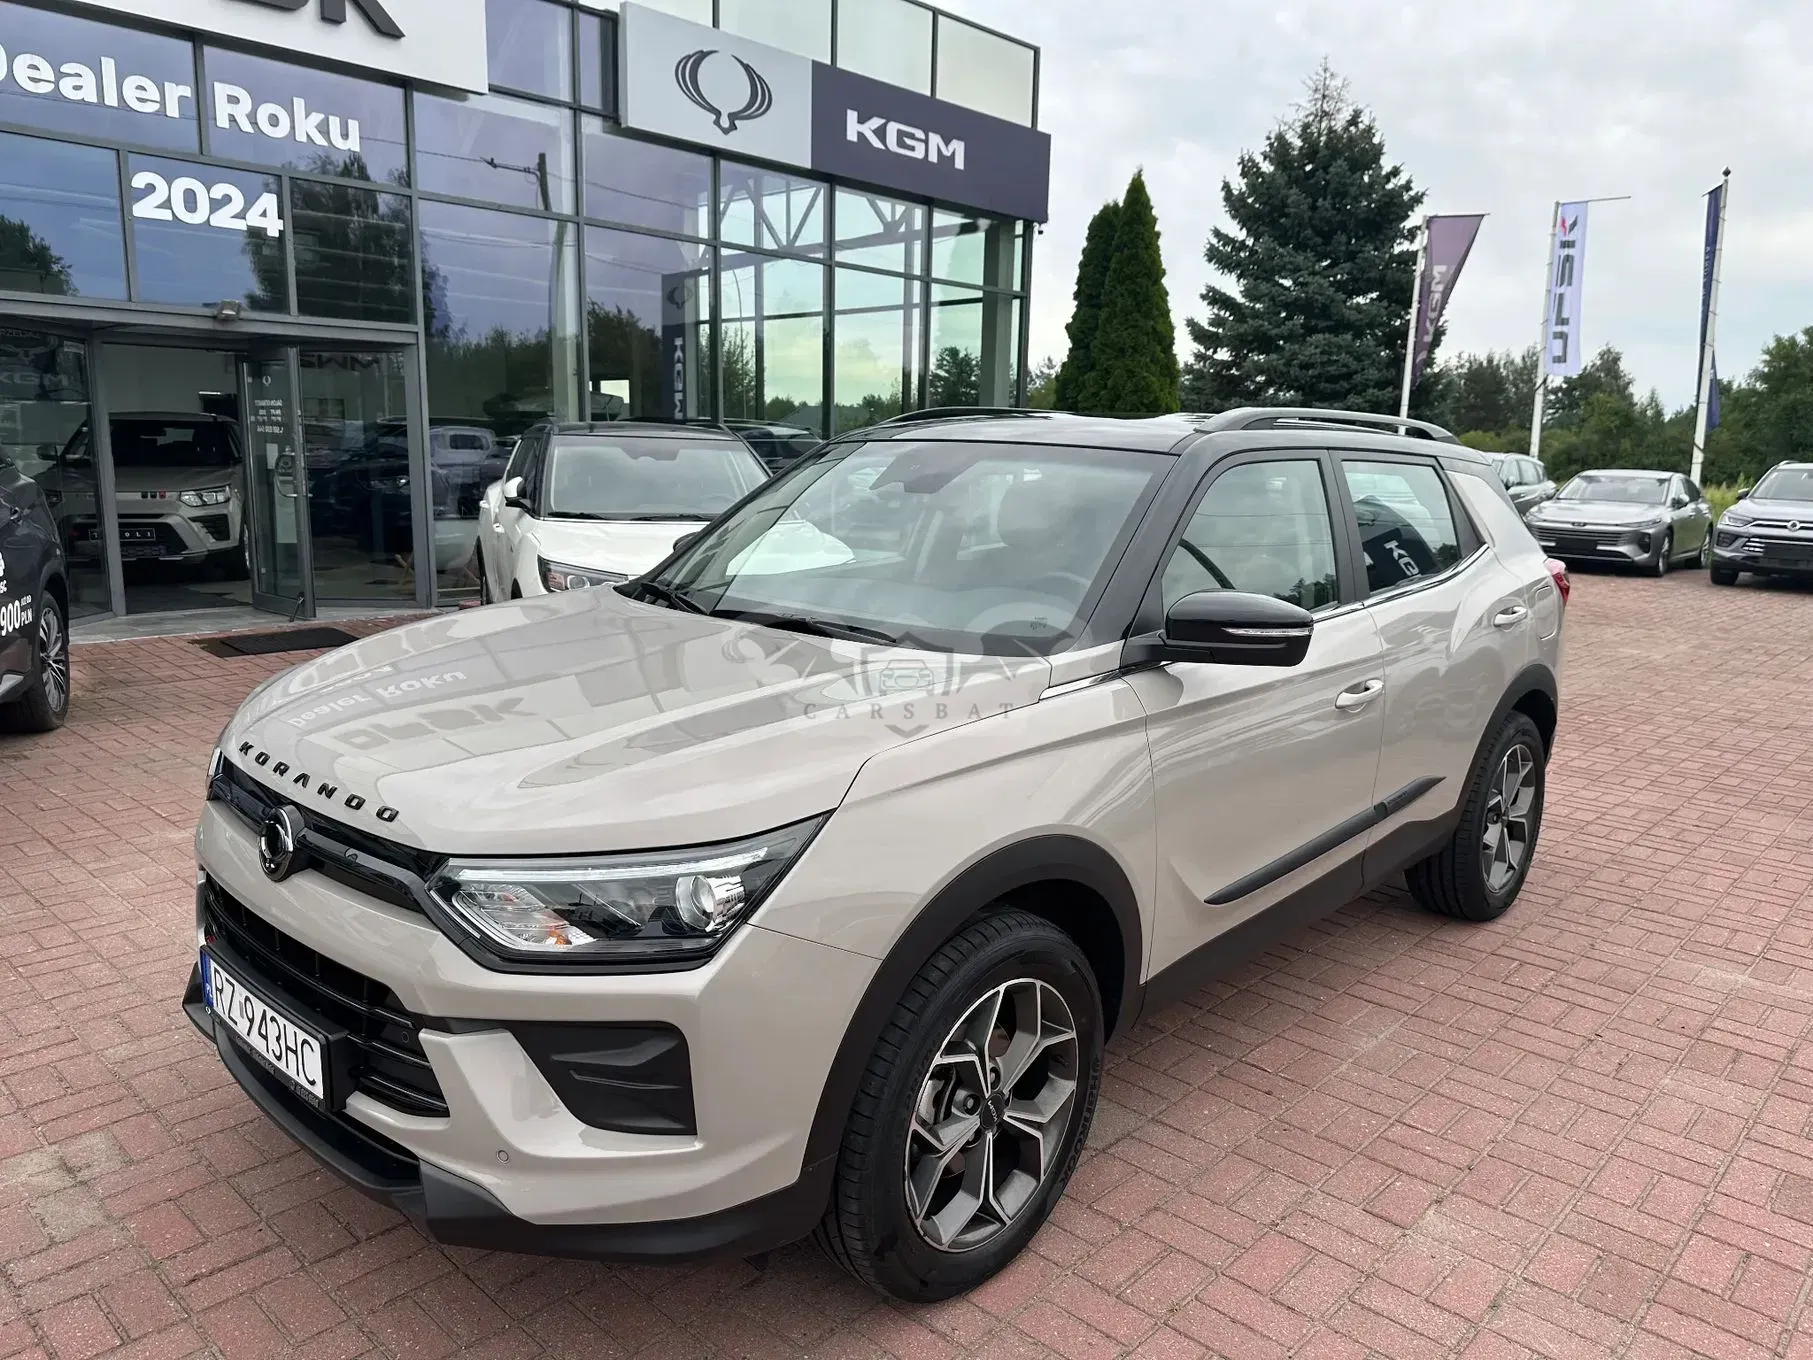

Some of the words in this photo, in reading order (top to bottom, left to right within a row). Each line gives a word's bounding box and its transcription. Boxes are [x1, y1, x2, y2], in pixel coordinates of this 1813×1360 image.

[0, 43, 191, 119] ealer
[212, 82, 361, 153] Roku
[846, 109, 966, 170] KGM
[130, 172, 284, 238] 2024
[1, 600, 20, 636] 900
[238, 741, 400, 823] KORANDO
[213, 967, 238, 1027] RZ
[244, 994, 317, 1087] 943HC
